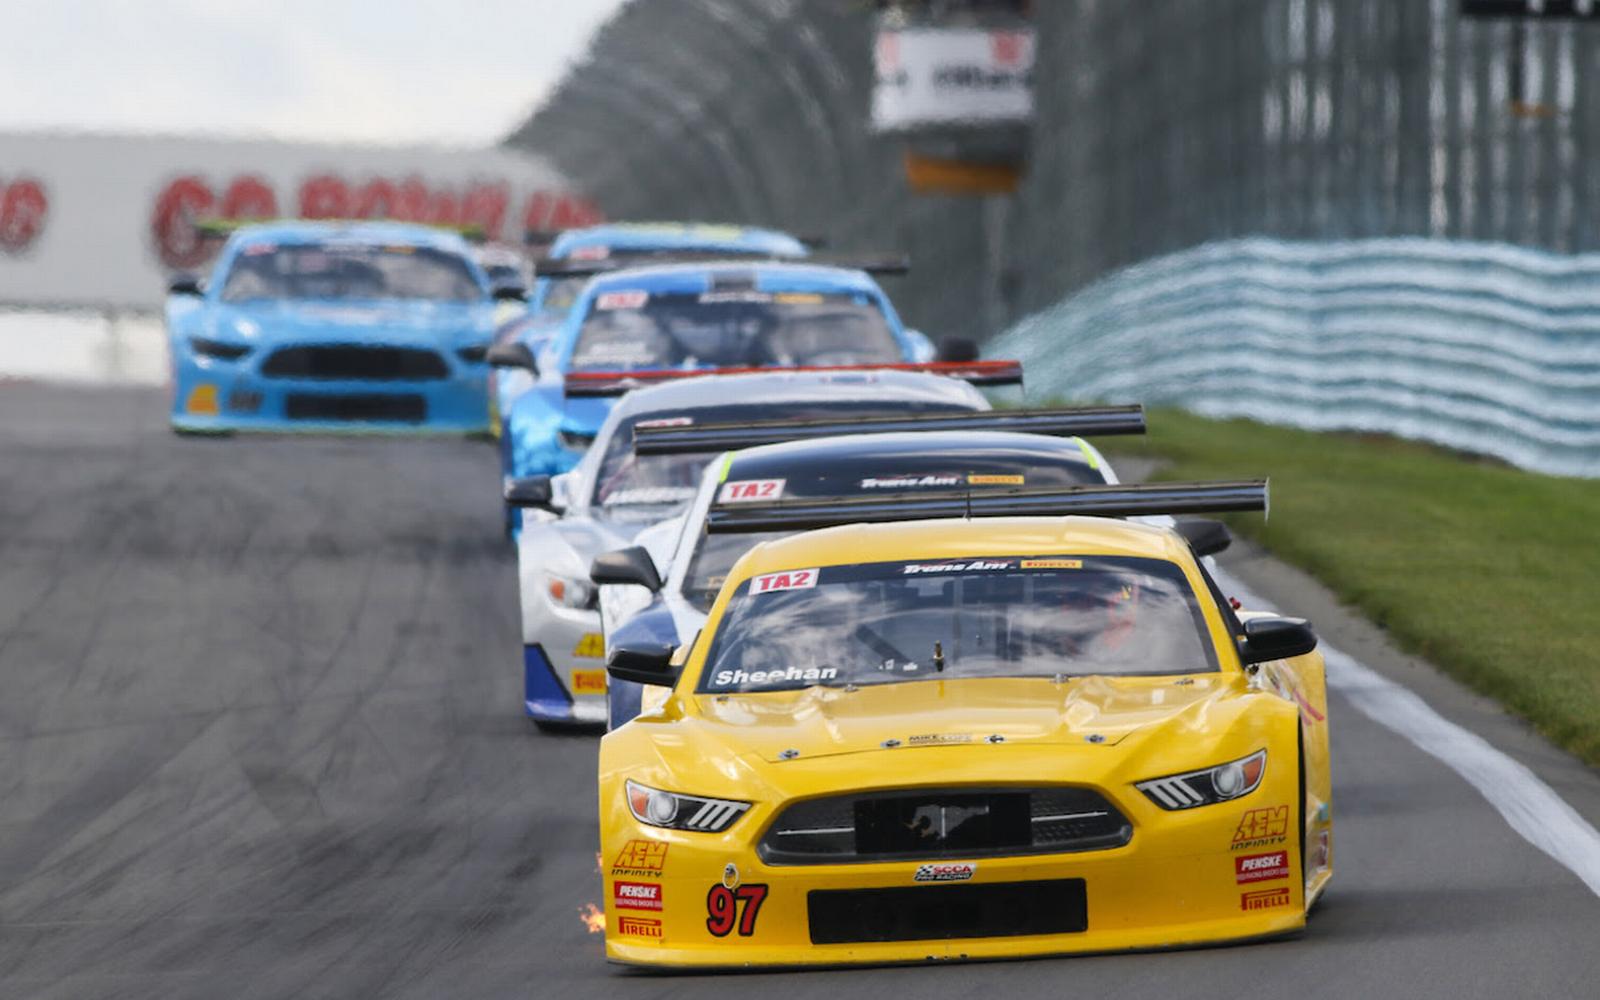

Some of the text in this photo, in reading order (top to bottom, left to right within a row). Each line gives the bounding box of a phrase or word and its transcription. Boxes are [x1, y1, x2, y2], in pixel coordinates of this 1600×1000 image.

[731, 482, 777, 498] TA2
[861, 475, 958, 489] Trans Am
[903, 560, 1009, 575] Trans Am
[759, 572, 810, 590] TA2
[715, 666, 837, 686] Sheehan
[933, 865, 972, 874] SCCA
[1241, 855, 1283, 871] PENSKE
[620, 885, 658, 898] PENSKE
[1241, 887, 1290, 911] PIRELLI
[706, 883, 768, 937] 97
[618, 916, 662, 937] PIRELLI
